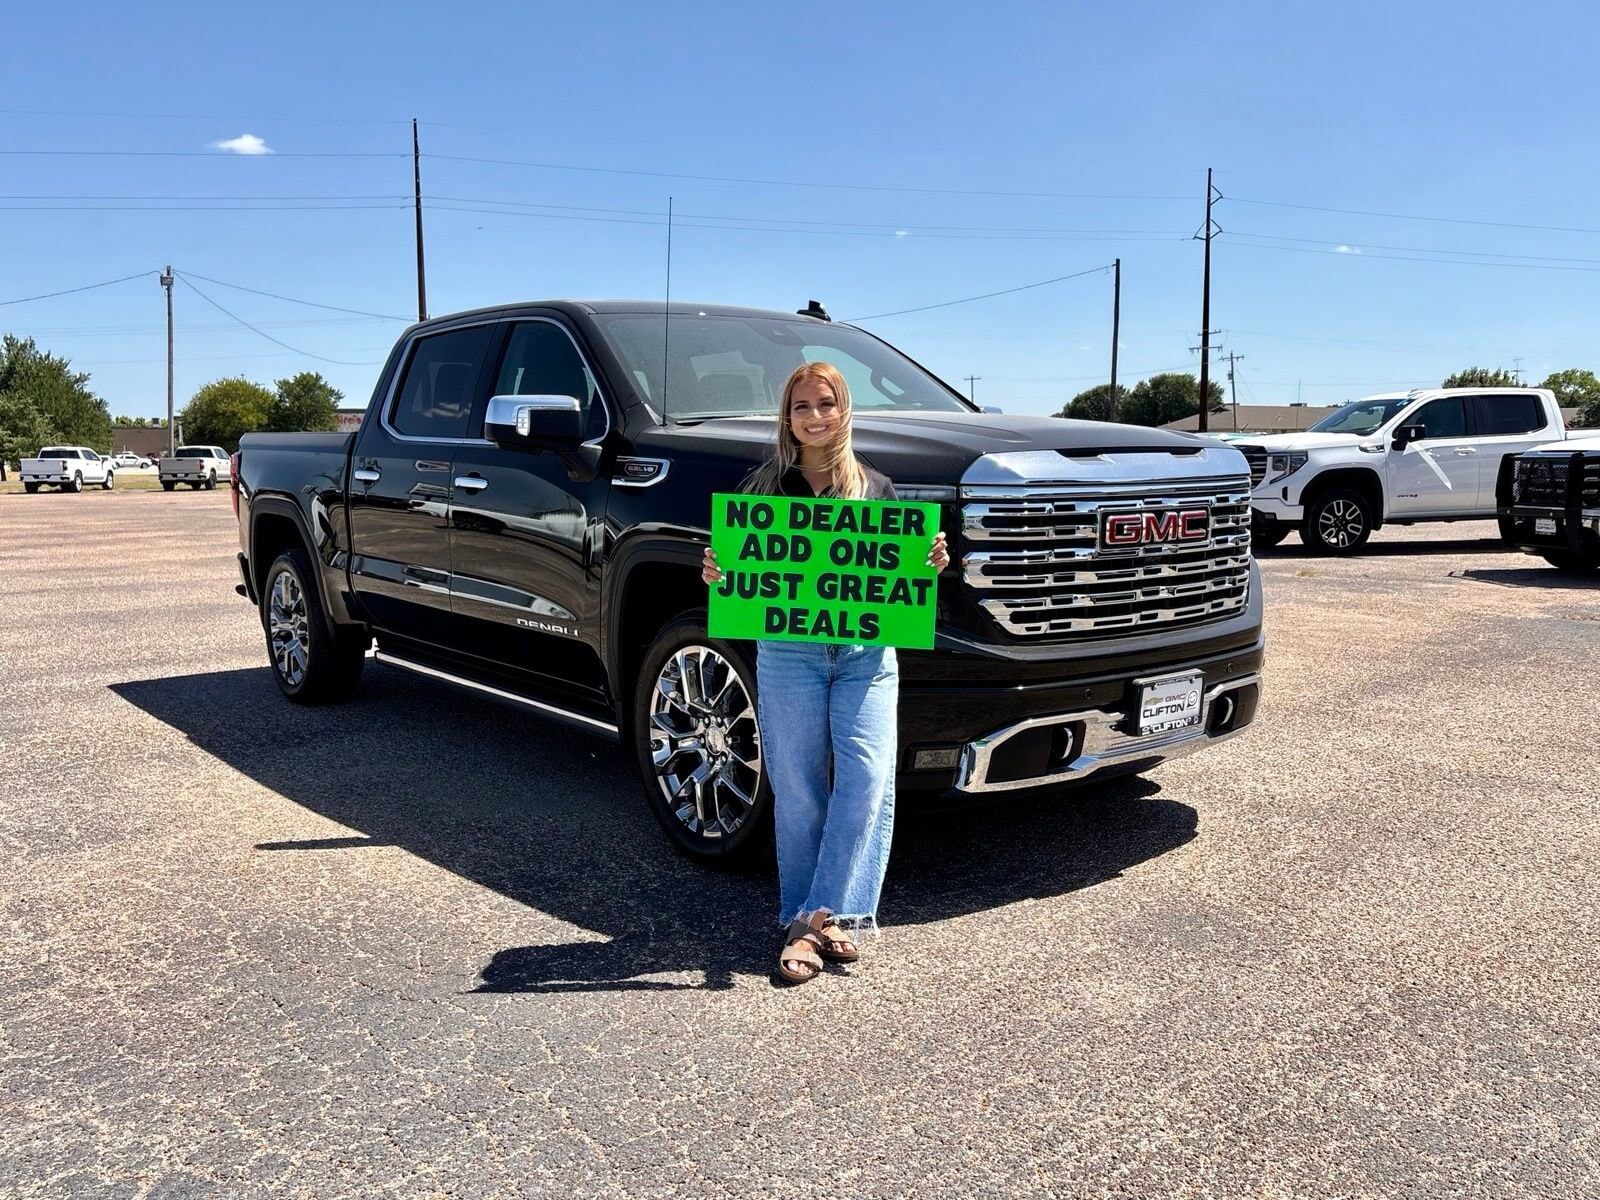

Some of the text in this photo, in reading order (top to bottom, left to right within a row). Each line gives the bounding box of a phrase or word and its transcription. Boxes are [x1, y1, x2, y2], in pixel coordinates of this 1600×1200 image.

[726, 500, 926, 537] NO DEALER
[1106, 510, 1207, 545] GMC
[738, 533, 901, 571] ADD ONS
[716, 570, 934, 607] JUST GREAT
[517, 618, 579, 637] DENALI
[764, 606, 880, 641] DEALS
[1143, 702, 1185, 718] CLIFTON
[1165, 693, 1187, 703] GMC
[1152, 717, 1188, 733] CLIFTON
